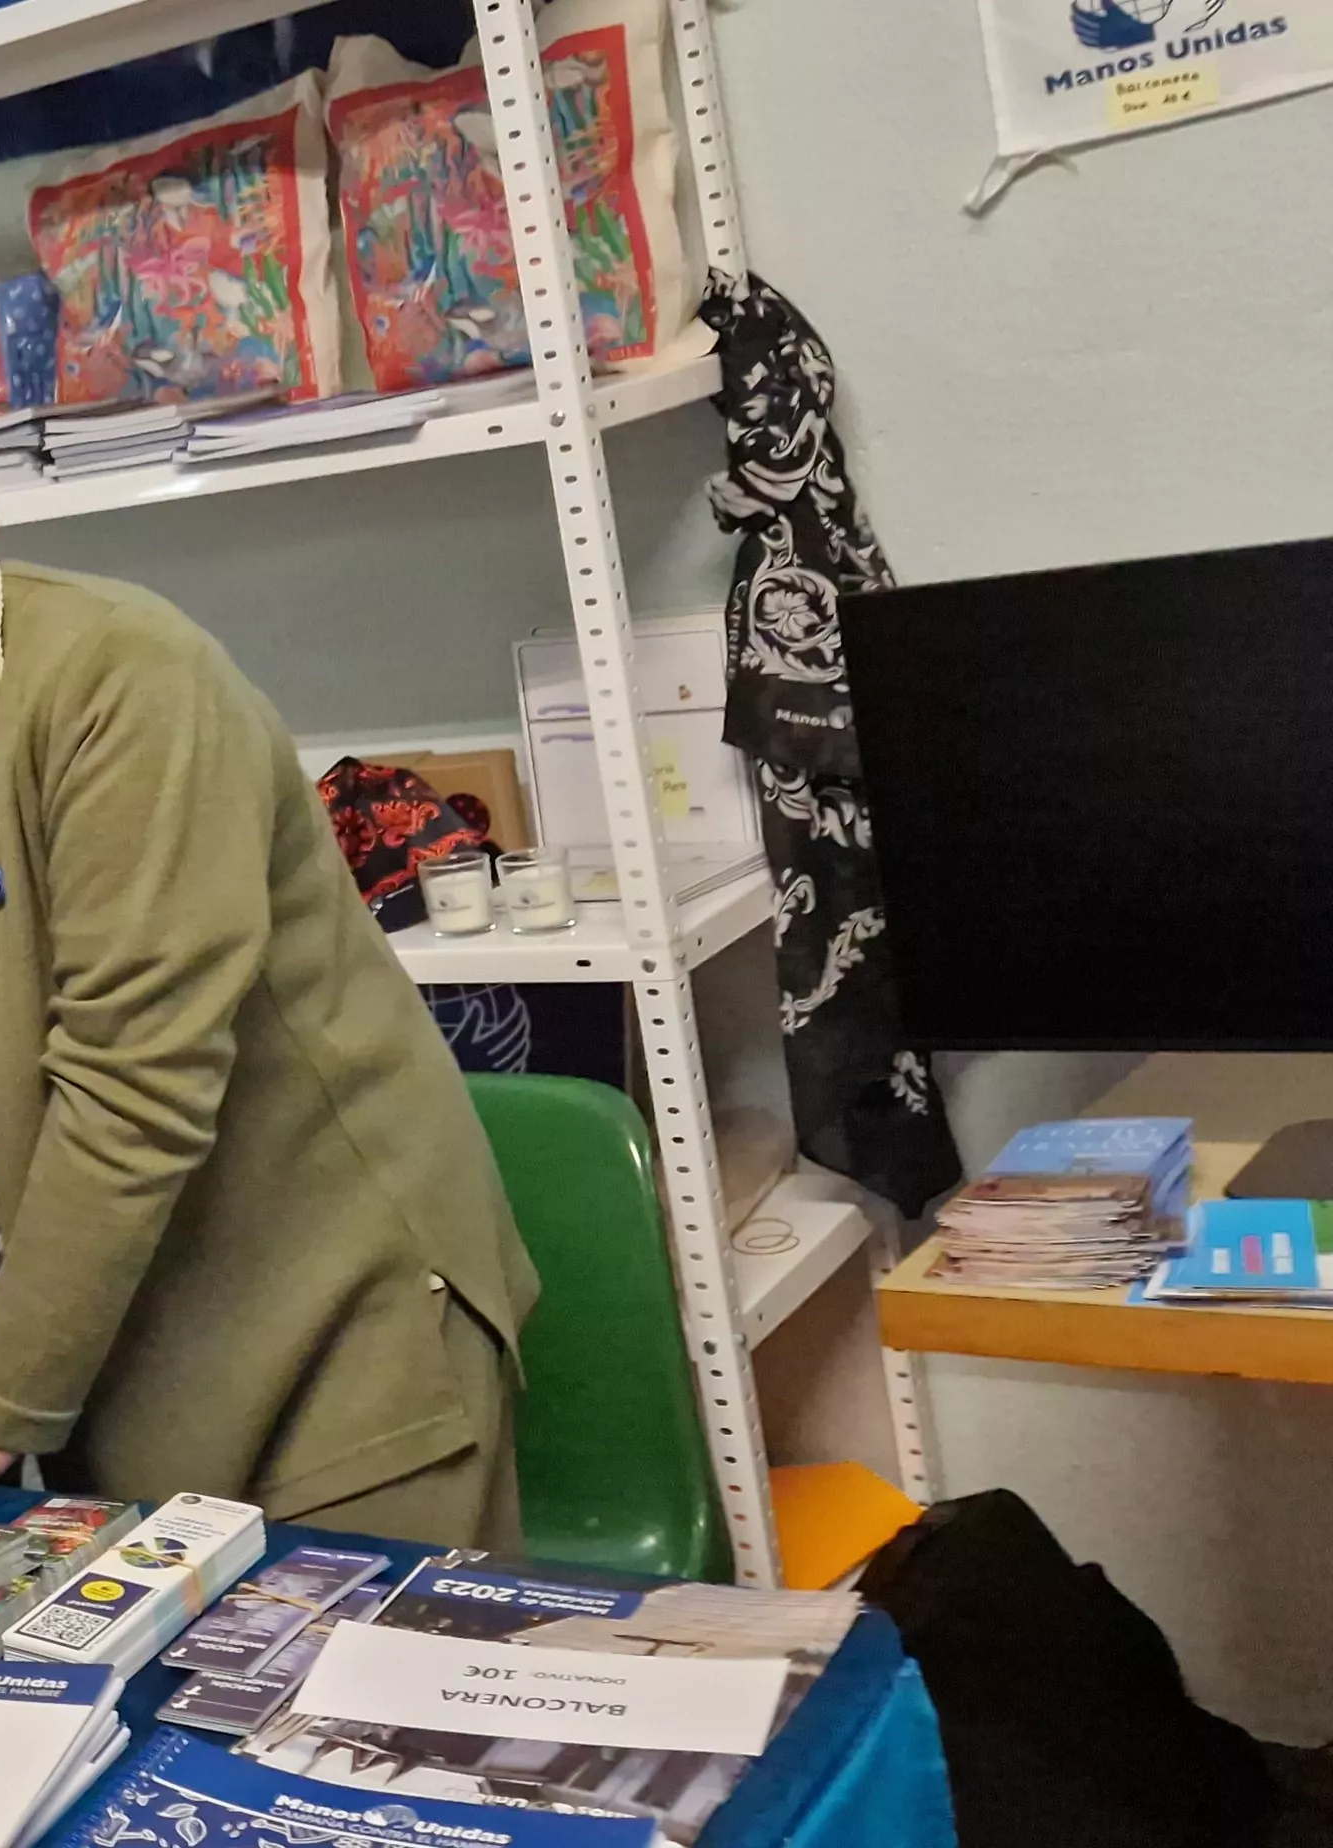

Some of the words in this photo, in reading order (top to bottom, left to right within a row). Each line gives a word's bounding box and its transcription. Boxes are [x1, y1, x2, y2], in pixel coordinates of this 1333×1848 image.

[1045, 50, 1154, 94] Manos
[1165, 16, 1288, 60] Unidas
[776, 708, 828, 728] Manos
[432, 1578, 518, 1602] 2023
[541, 1598, 611, 1615] Memoria
[463, 1665, 519, 1681] 10€
[9, 1686, 63, 1698] HAMBRE
[441, 1689, 629, 1717] BALCONERA
[269, 1807, 345, 1830] CAMPAÑA
[347, 1823, 413, 1843] CONTRA
[275, 1794, 363, 1822] Manos
[414, 1820, 513, 1845] Unidas
